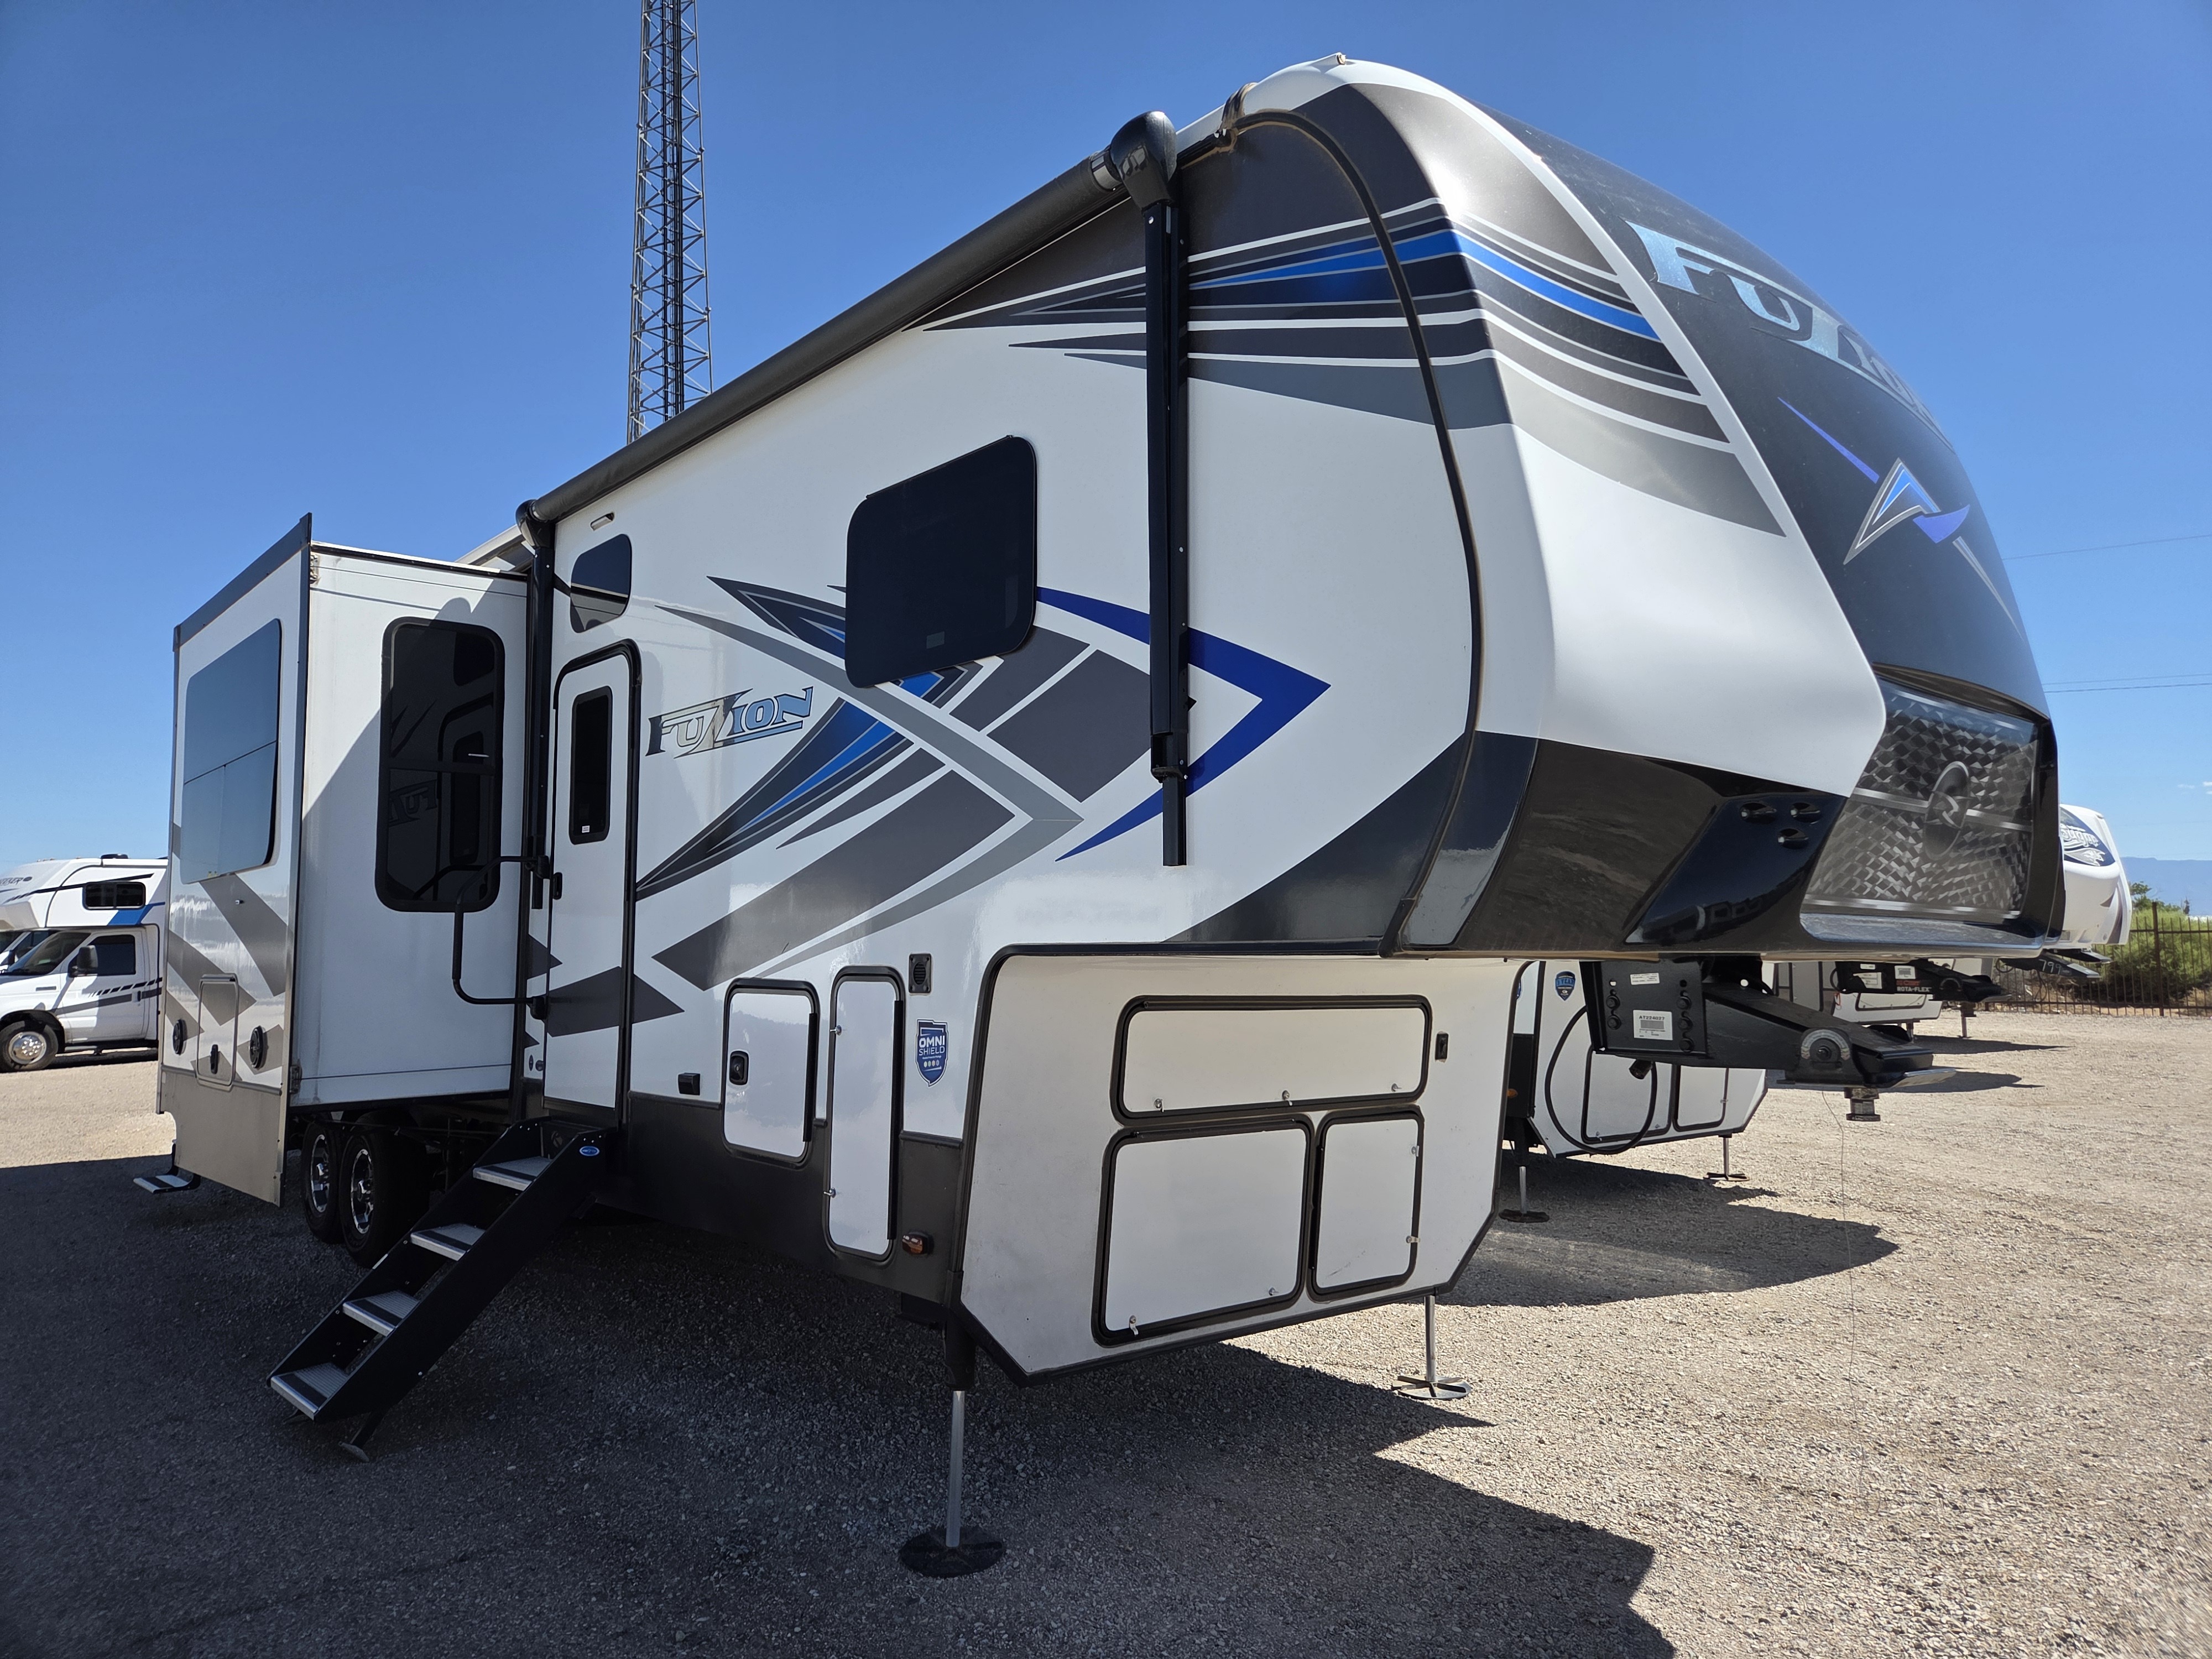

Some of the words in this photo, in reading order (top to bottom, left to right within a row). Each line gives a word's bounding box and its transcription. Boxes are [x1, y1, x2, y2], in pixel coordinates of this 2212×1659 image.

[645, 686, 813, 759] FUZION
[919, 1035, 945, 1048] OMNI
[919, 1046, 945, 1056] SHIELD
